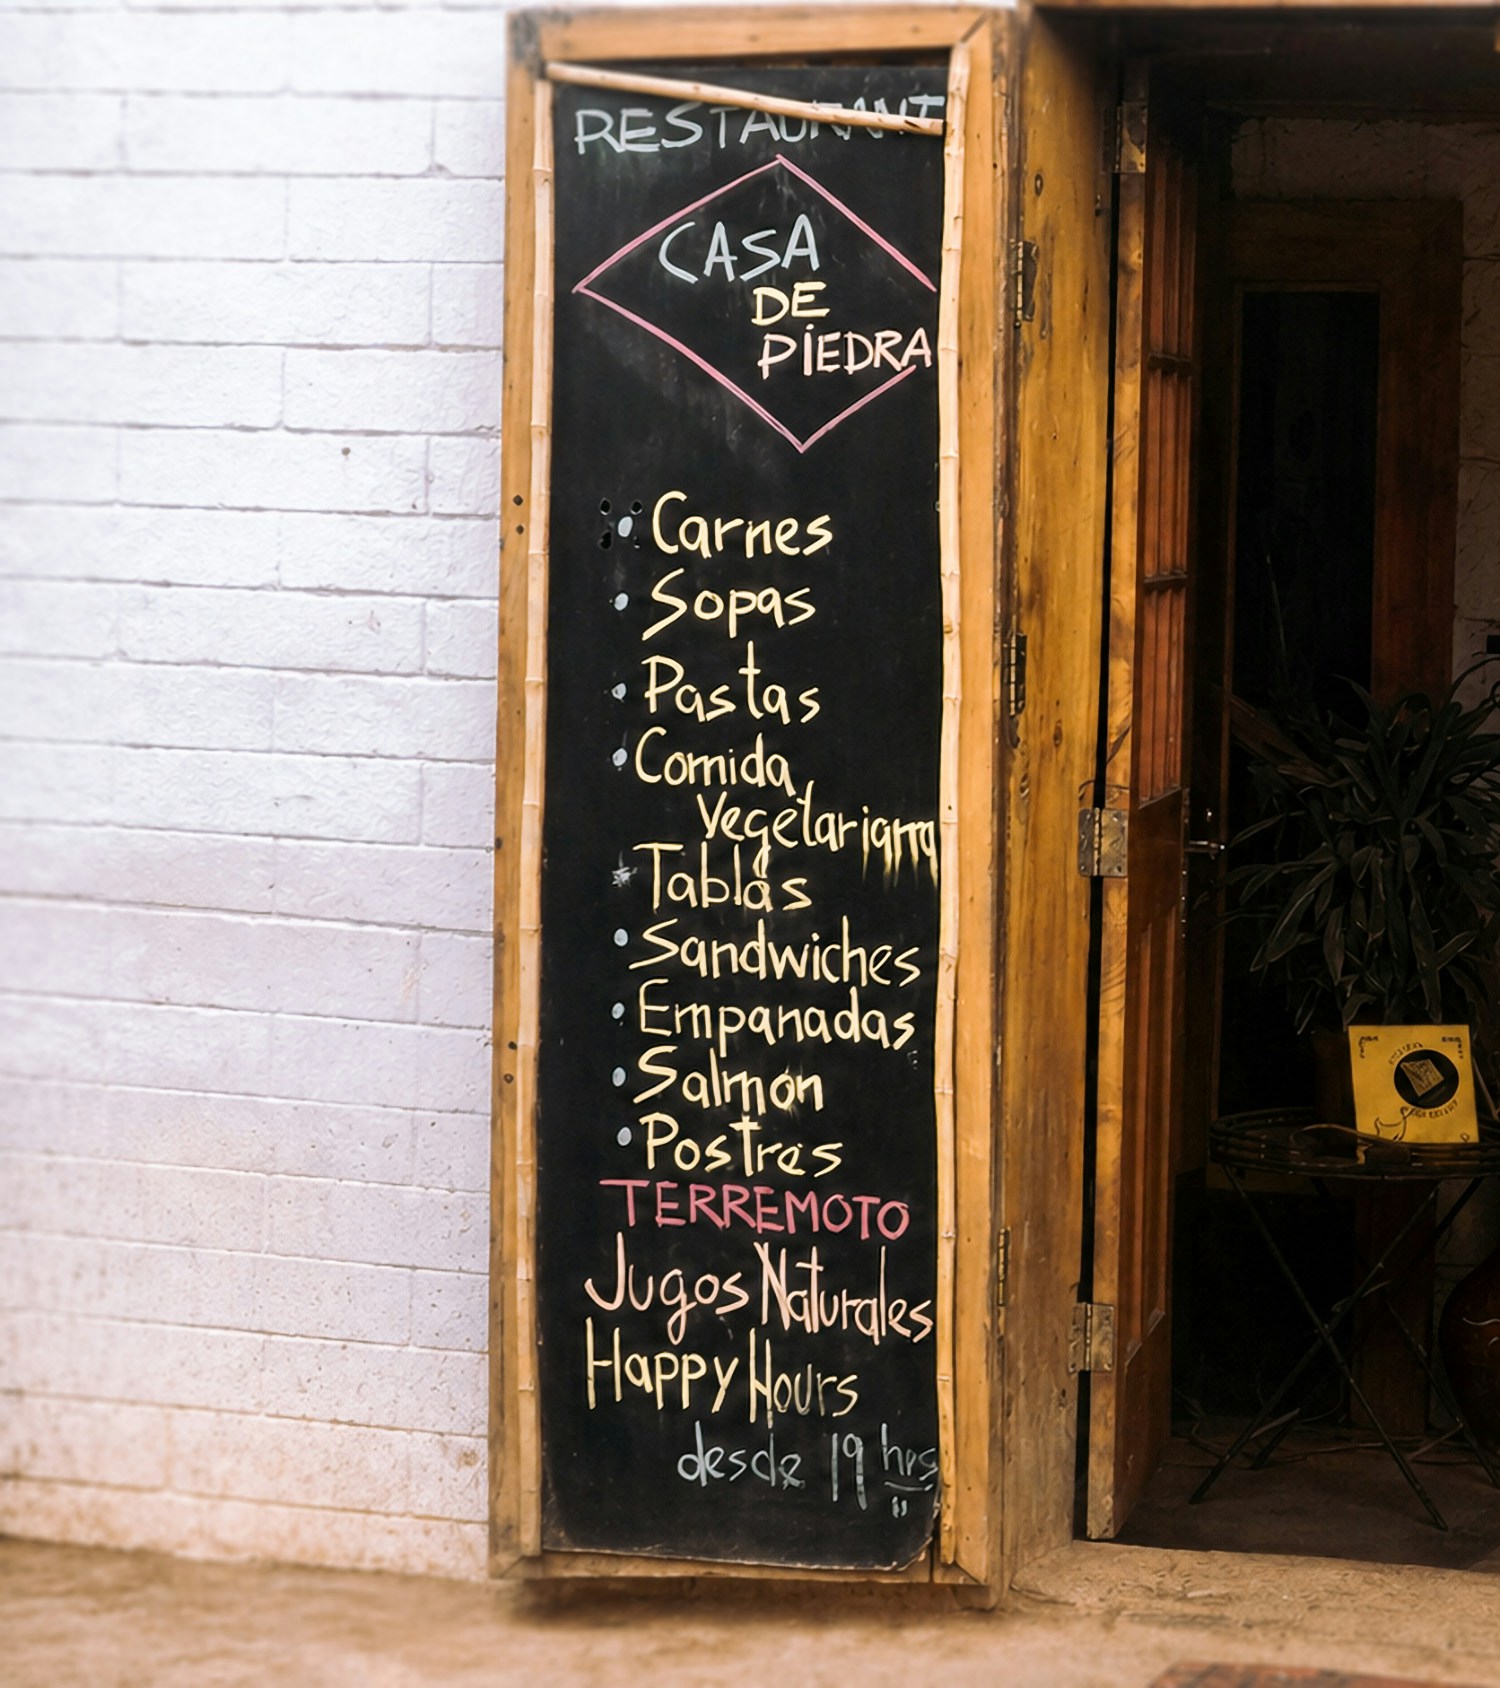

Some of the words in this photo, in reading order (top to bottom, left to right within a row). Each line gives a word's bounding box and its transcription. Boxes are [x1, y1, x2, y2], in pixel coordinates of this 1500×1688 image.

[658, 214, 820, 284] CASA
[751, 281, 831, 326] DE
[652, 490, 833, 559] Carnes
[642, 568, 816, 641] Sopas
[641, 641, 821, 725] Pastas
[635, 727, 796, 797] Comida
[697, 780, 939, 882] Vegetariana
[633, 842, 812, 914] Tablas
[629, 915, 922, 987] Sandwiches
[638, 978, 915, 1057] Empanadas
[639, 1112, 843, 1178] Postres
[599, 1179, 911, 1241] TERREMOTO
[584, 1231, 750, 1345] Jugos
[754, 1241, 934, 1345] Naturales
[586, 1317, 739, 1413] Happy
[749, 1327, 859, 1429] Hours
[677, 1420, 806, 1490] desde
[831, 1432, 867, 1511] 19
[881, 1423, 939, 1482] hrs
